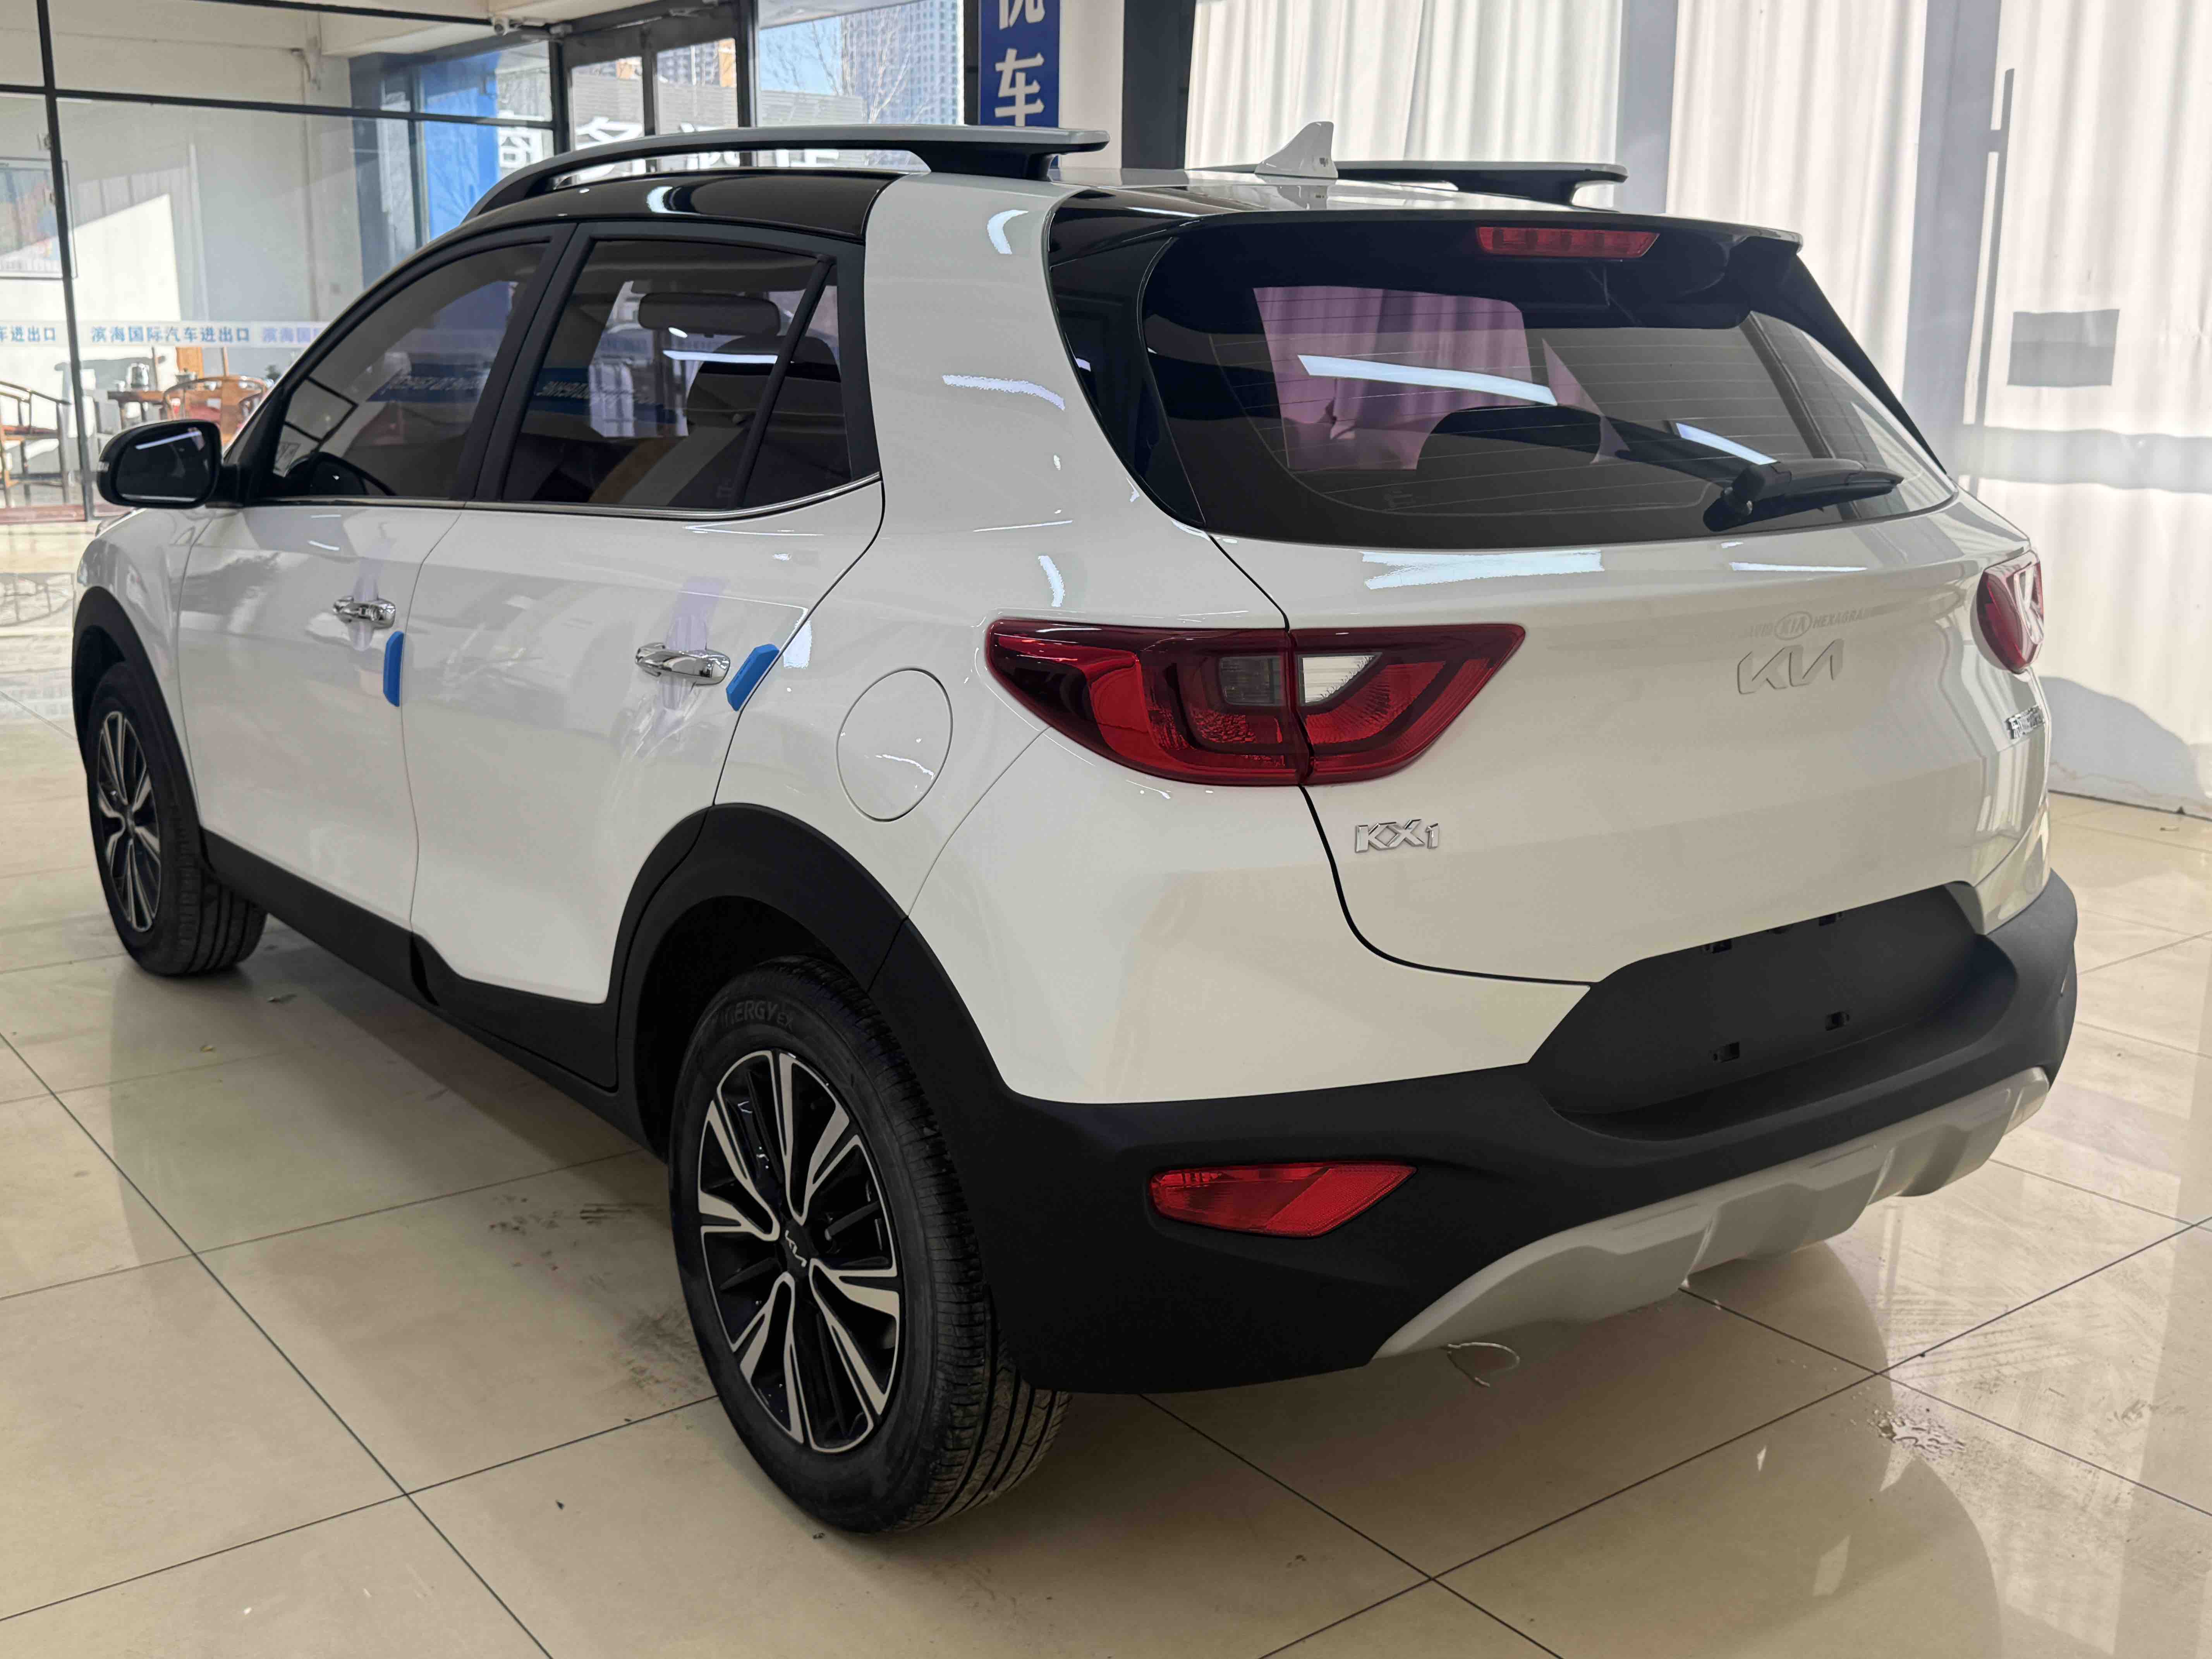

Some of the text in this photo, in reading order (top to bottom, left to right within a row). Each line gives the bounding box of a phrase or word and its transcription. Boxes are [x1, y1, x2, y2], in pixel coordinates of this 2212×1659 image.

[91, 326, 250, 343] 滨海国际汽车进出口
[1355, 818, 1441, 853] KX1
